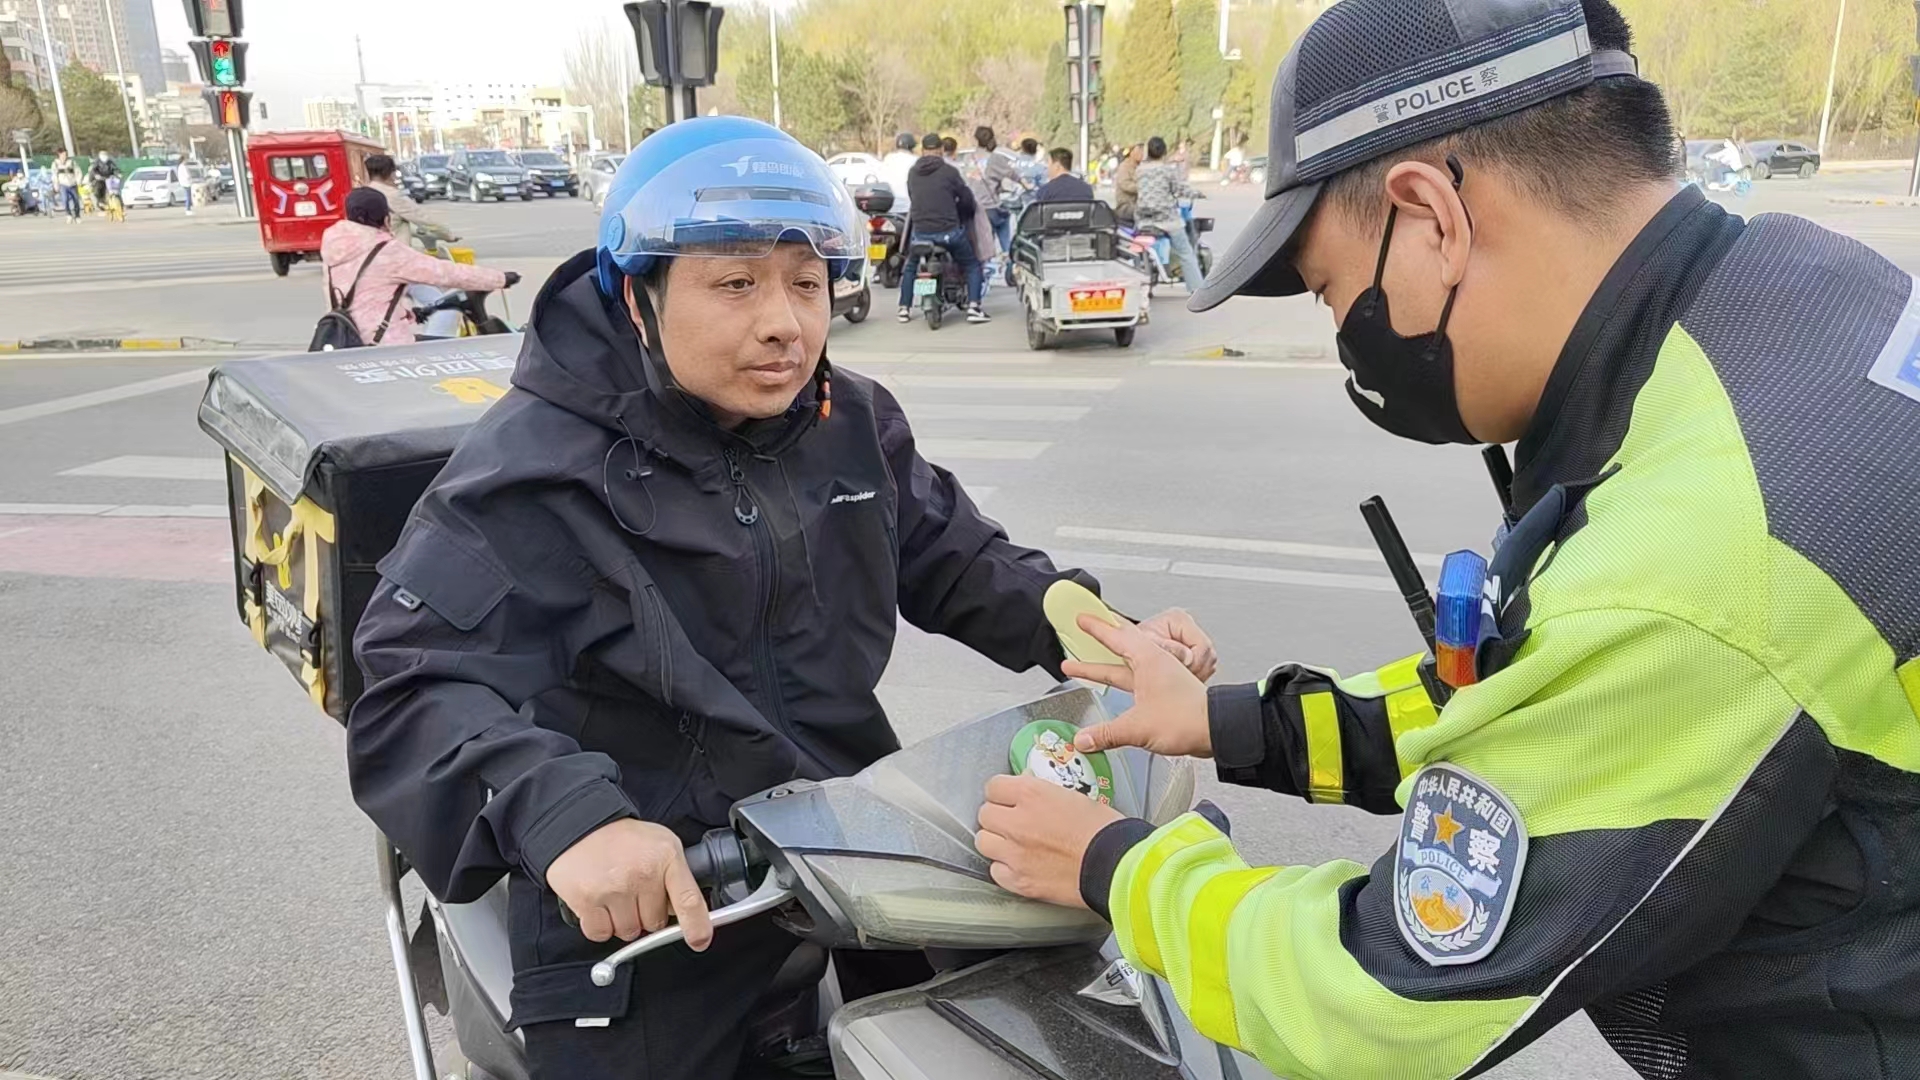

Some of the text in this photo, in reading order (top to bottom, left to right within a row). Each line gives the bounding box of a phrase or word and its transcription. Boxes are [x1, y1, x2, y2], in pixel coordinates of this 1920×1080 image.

[1395, 75, 1476, 116] POLICE
[1479, 66, 1499, 87] 察
[1417, 774, 1513, 838] 中华人民共和国
[1420, 850, 1468, 881] POLICE
